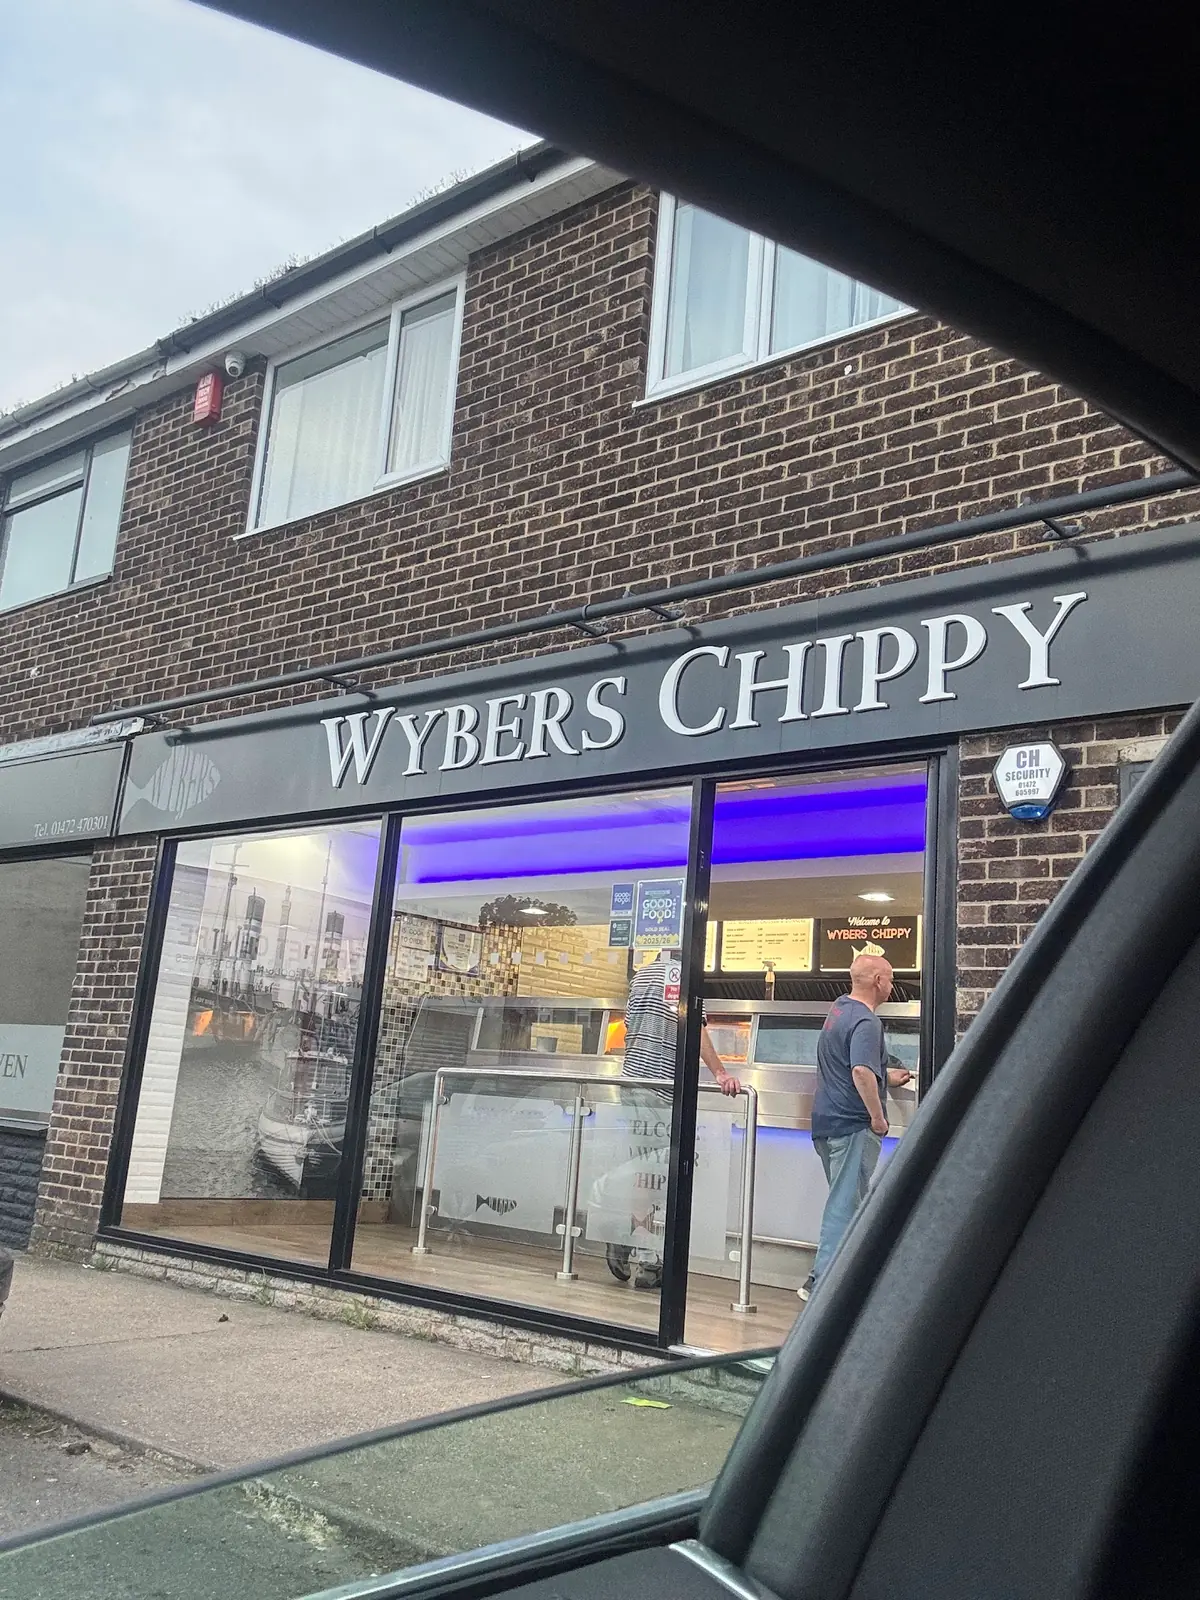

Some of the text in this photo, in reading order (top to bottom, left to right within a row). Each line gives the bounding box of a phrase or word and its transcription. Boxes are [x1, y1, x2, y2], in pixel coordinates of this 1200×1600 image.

[320, 592, 1087, 789] WYBERS CHIPPY
[1016, 749, 1040, 768] CH
[1005, 768, 1051, 782] SECURITY
[1018, 781, 1037, 789] 01472
[33, 815, 109, 838] Tel. 01472 470301
[642, 898, 673, 909] GOOD
[642, 909, 672, 919] FOOD
[848, 915, 891, 926] Welcome to
[827, 928, 911, 940] WYBERS CHIPPY
[643, 937, 671, 945] 2025/26
